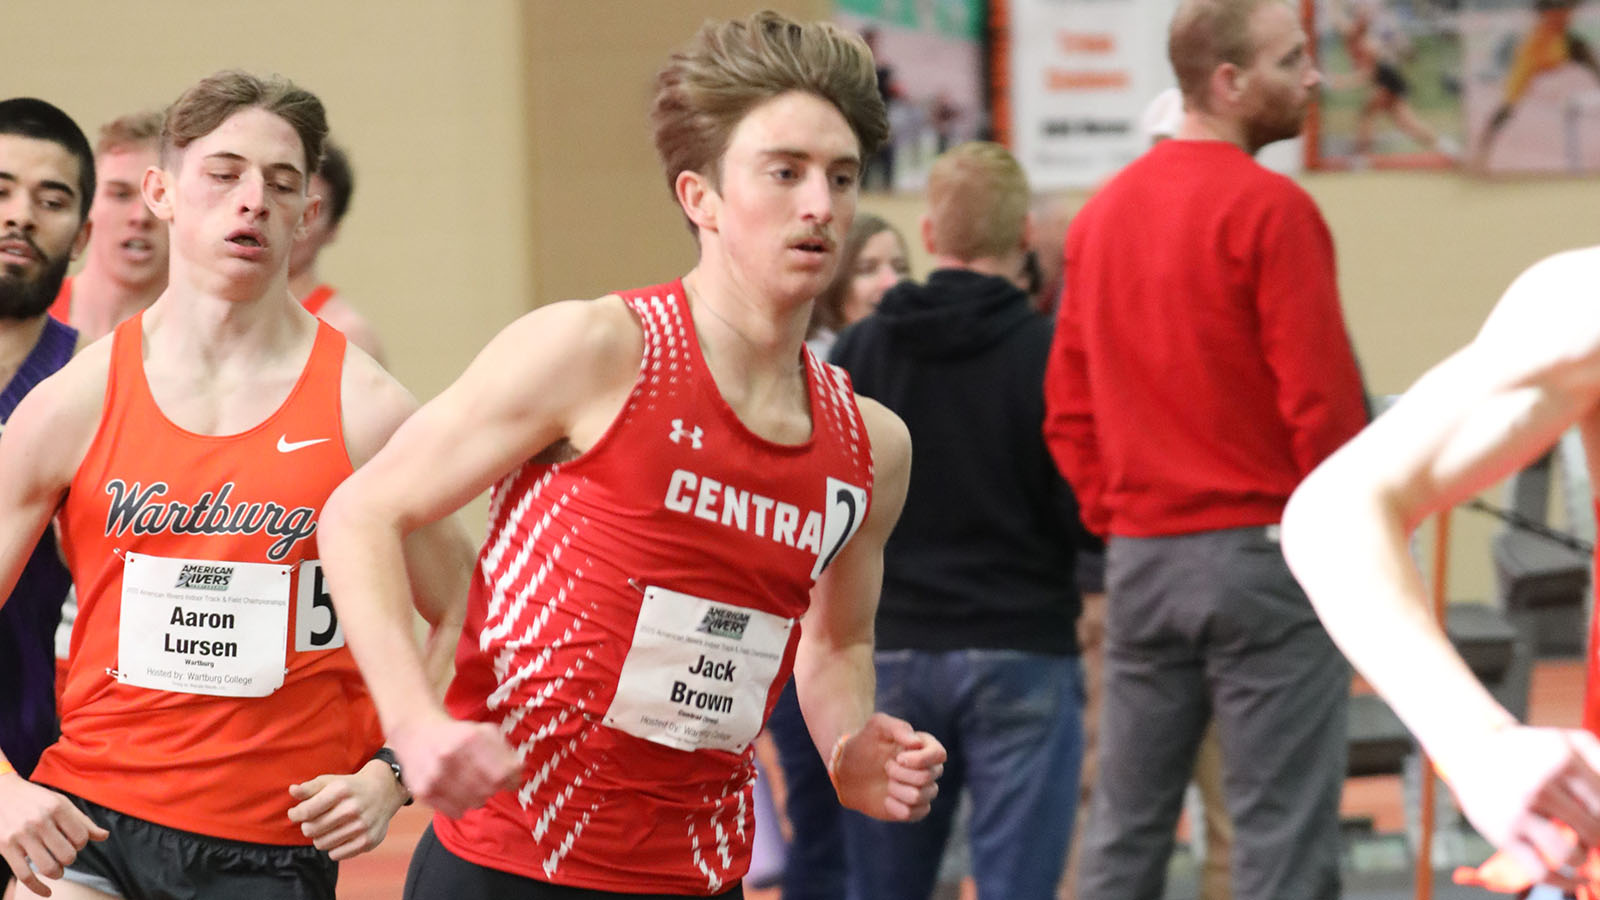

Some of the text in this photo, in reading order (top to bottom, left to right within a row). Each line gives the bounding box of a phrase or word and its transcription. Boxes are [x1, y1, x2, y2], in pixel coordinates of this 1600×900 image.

[105, 479, 317, 560] Wartburg
[664, 469, 822, 555] CENTRA
[182, 565, 234, 574] AMERICAN
[170, 606, 235, 629] Aaron
[310, 565, 338, 646] 5
[164, 633, 237, 657] Lursen
[185, 659, 214, 668] Wartburg
[688, 654, 737, 682] Jack
[147, 668, 171, 678] Hosted
[187, 672, 222, 684] Wartburg
[224, 674, 252, 685] College
[670, 680, 733, 713] Brown
[640, 715, 668, 728] Hosted
